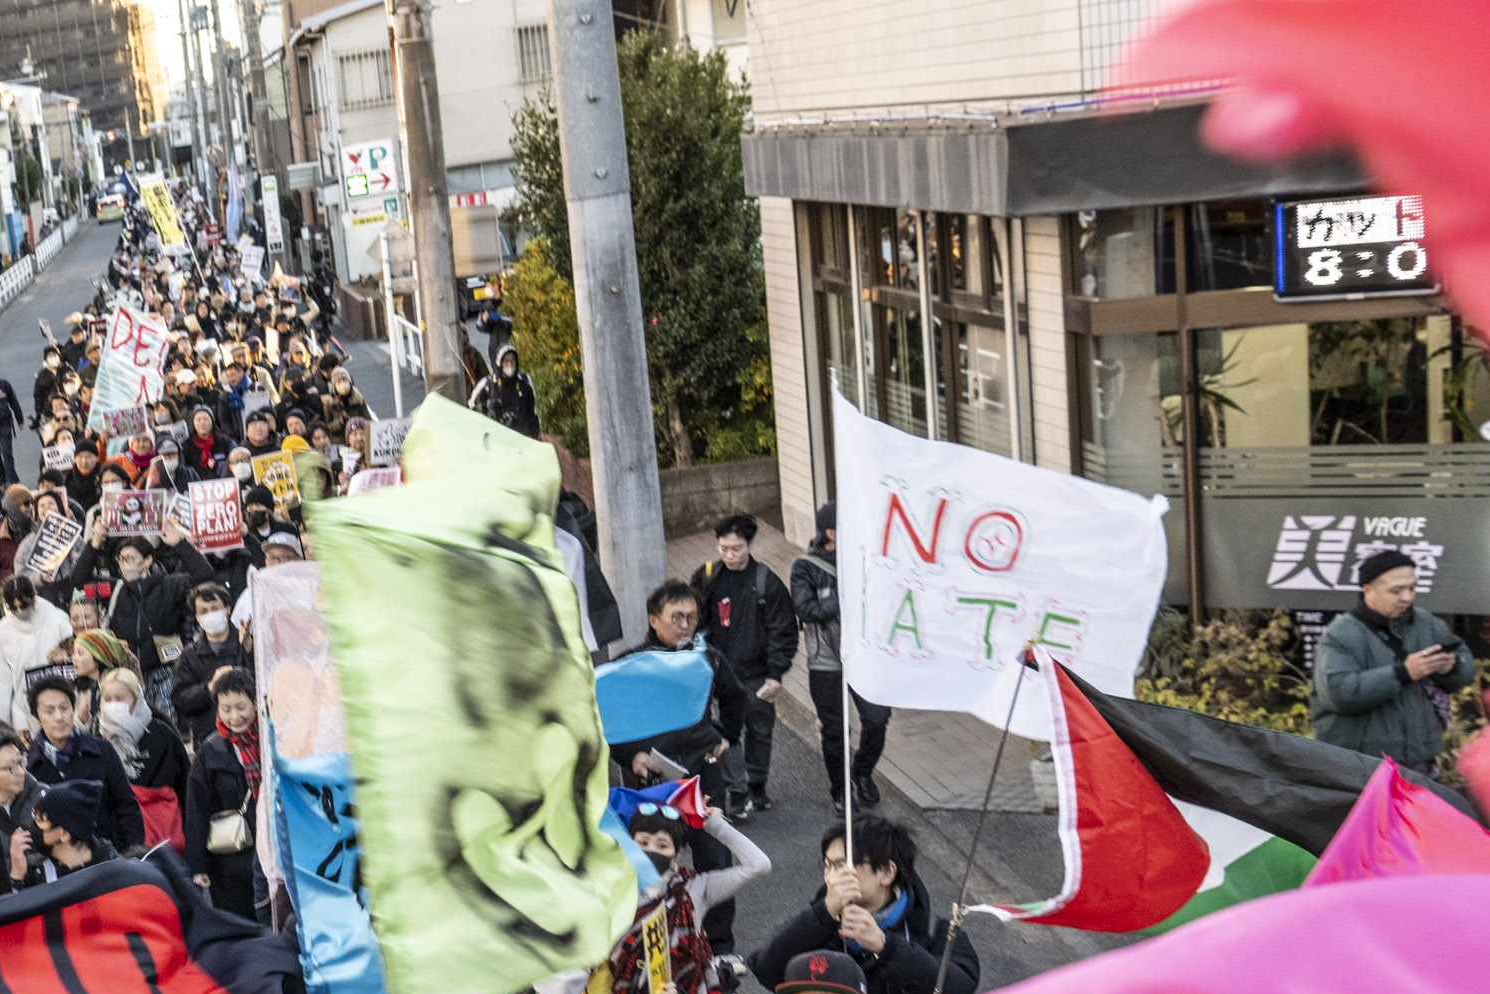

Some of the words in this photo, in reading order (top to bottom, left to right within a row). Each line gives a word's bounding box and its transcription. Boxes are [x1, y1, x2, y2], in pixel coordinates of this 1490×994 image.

[368, 146, 388, 170] P
[1305, 198, 1423, 243] カット
[193, 481, 235, 503] STOP
[195, 501, 238, 520] ZERO
[196, 517, 238, 535] PLAN!
[873, 475, 1031, 578] NO
[1363, 516, 1428, 538] VAGUE
[860, 560, 1088, 672] ATE
